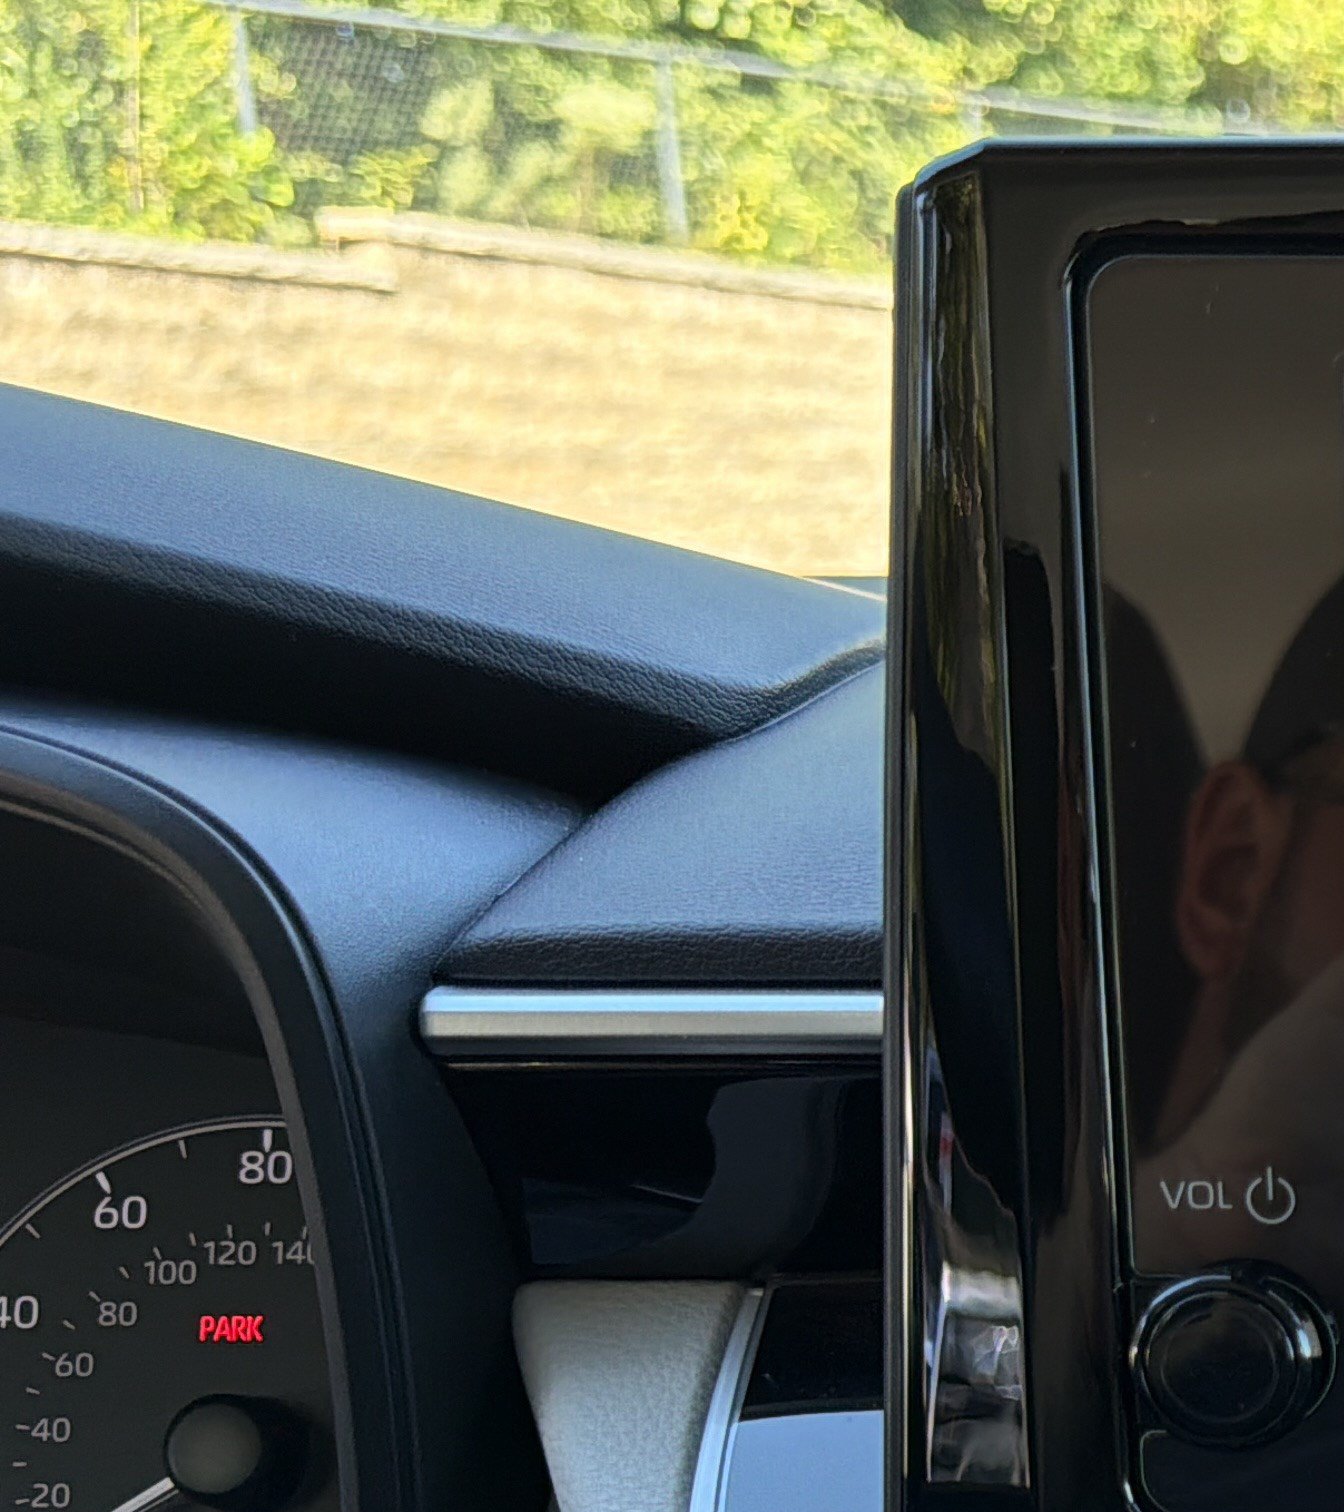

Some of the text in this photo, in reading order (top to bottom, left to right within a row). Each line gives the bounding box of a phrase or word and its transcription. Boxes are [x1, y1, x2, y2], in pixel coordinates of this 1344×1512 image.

[239, 1150, 292, 1185] 80
[1159, 1181, 1233, 1210] VOL
[94, 1196, 147, 1229] 60
[204, 1240, 256, 1266] 120
[144, 1259, 197, 1285] 100
[98, 1301, 138, 1326] 80
[199, 1315, 264, 1343] PARK
[55, 1353, 94, 1377] 60
[30, 1418, 71, 1443] 40
[31, 1483, 71, 1508] 20
